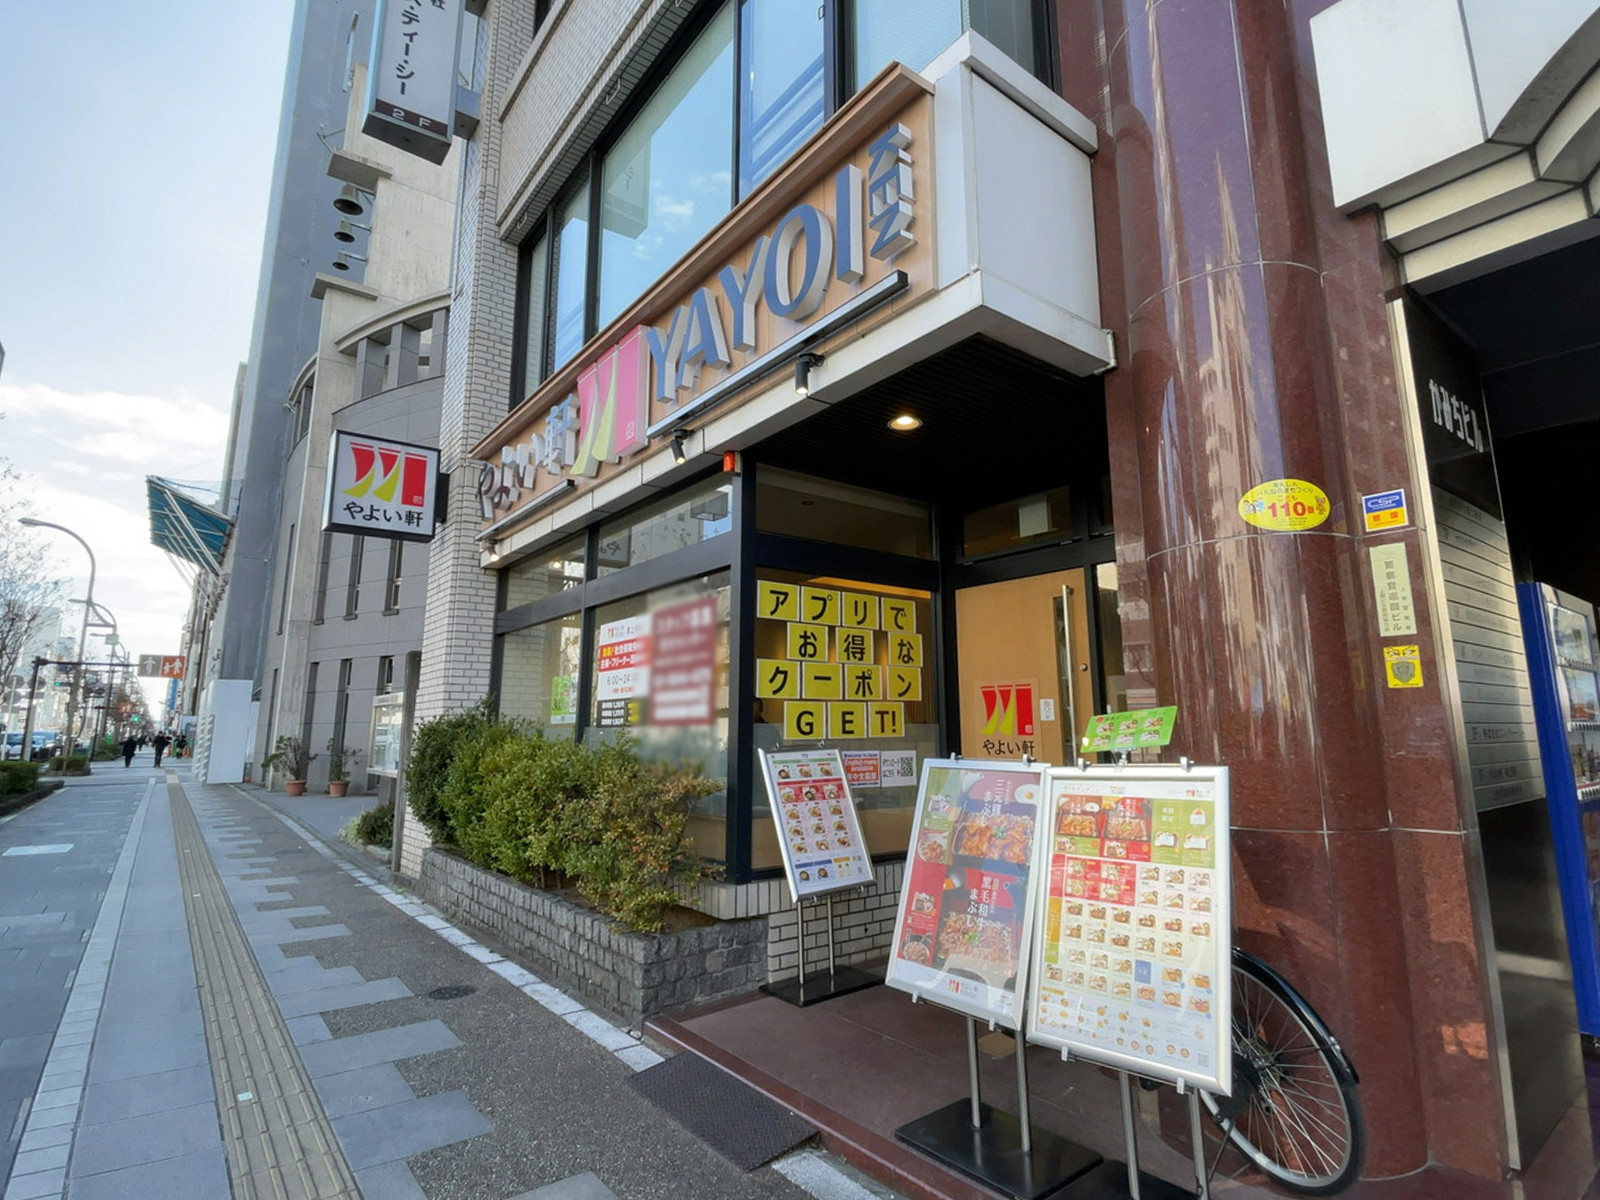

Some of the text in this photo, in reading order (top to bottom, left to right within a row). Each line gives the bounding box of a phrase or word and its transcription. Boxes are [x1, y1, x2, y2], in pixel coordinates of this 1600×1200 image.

[392, 108, 431, 127] 2F
[867, 122, 917, 261] KEN
[646, 164, 864, 403] YAYOI
[476, 392, 580, 520] やよい軒
[342, 500, 424, 528] やよい軒
[1367, 495, 1400, 509] CSP
[769, 589, 908, 631] アプリで
[798, 630, 914, 664] お得な
[768, 666, 912, 698] クーポン
[795, 710, 897, 736] GET!
[982, 739, 1035, 756] やよい軒
